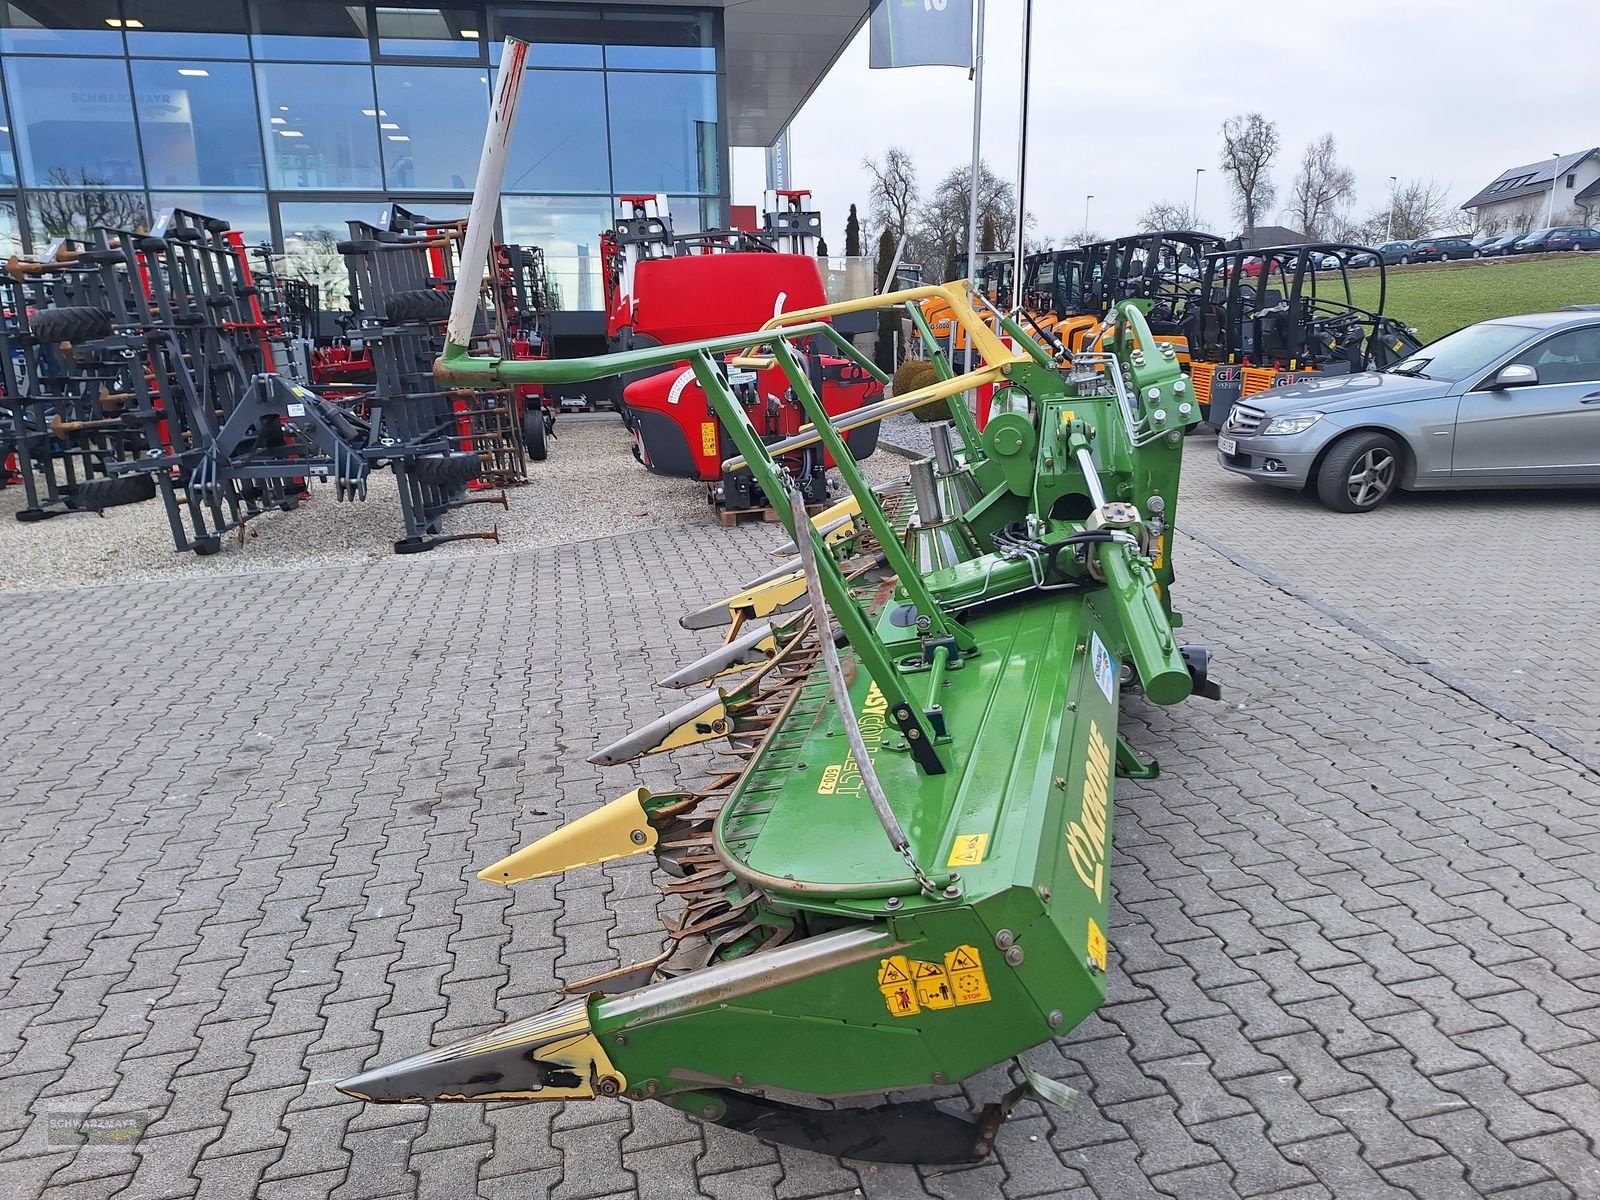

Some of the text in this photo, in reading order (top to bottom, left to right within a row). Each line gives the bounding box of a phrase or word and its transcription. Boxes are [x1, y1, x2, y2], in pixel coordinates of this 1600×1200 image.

[820, 768, 839, 791] 600-2
[1080, 719, 1111, 862] KRONE
[962, 992, 982, 1001] STOP
